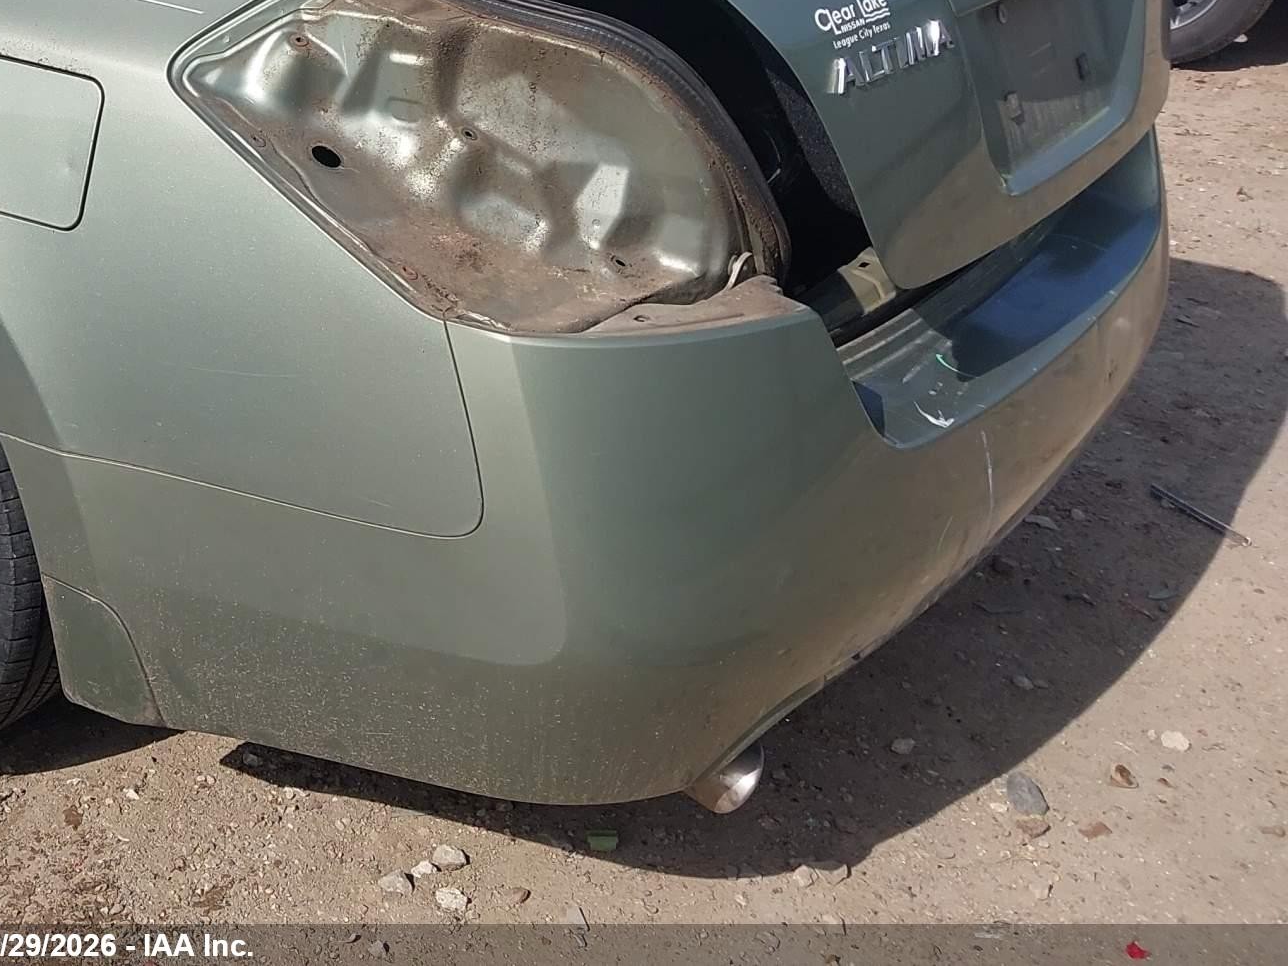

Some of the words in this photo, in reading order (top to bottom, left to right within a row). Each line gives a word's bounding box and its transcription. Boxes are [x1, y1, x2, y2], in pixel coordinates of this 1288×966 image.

[814, 4, 856, 35] Clear
[841, 18, 866, 34] NISSAN
[833, 34, 859, 49] League
[858, 25, 873, 38] City
[873, 21, 891, 34] Texas
[827, 19, 955, 94] ALTIMA
